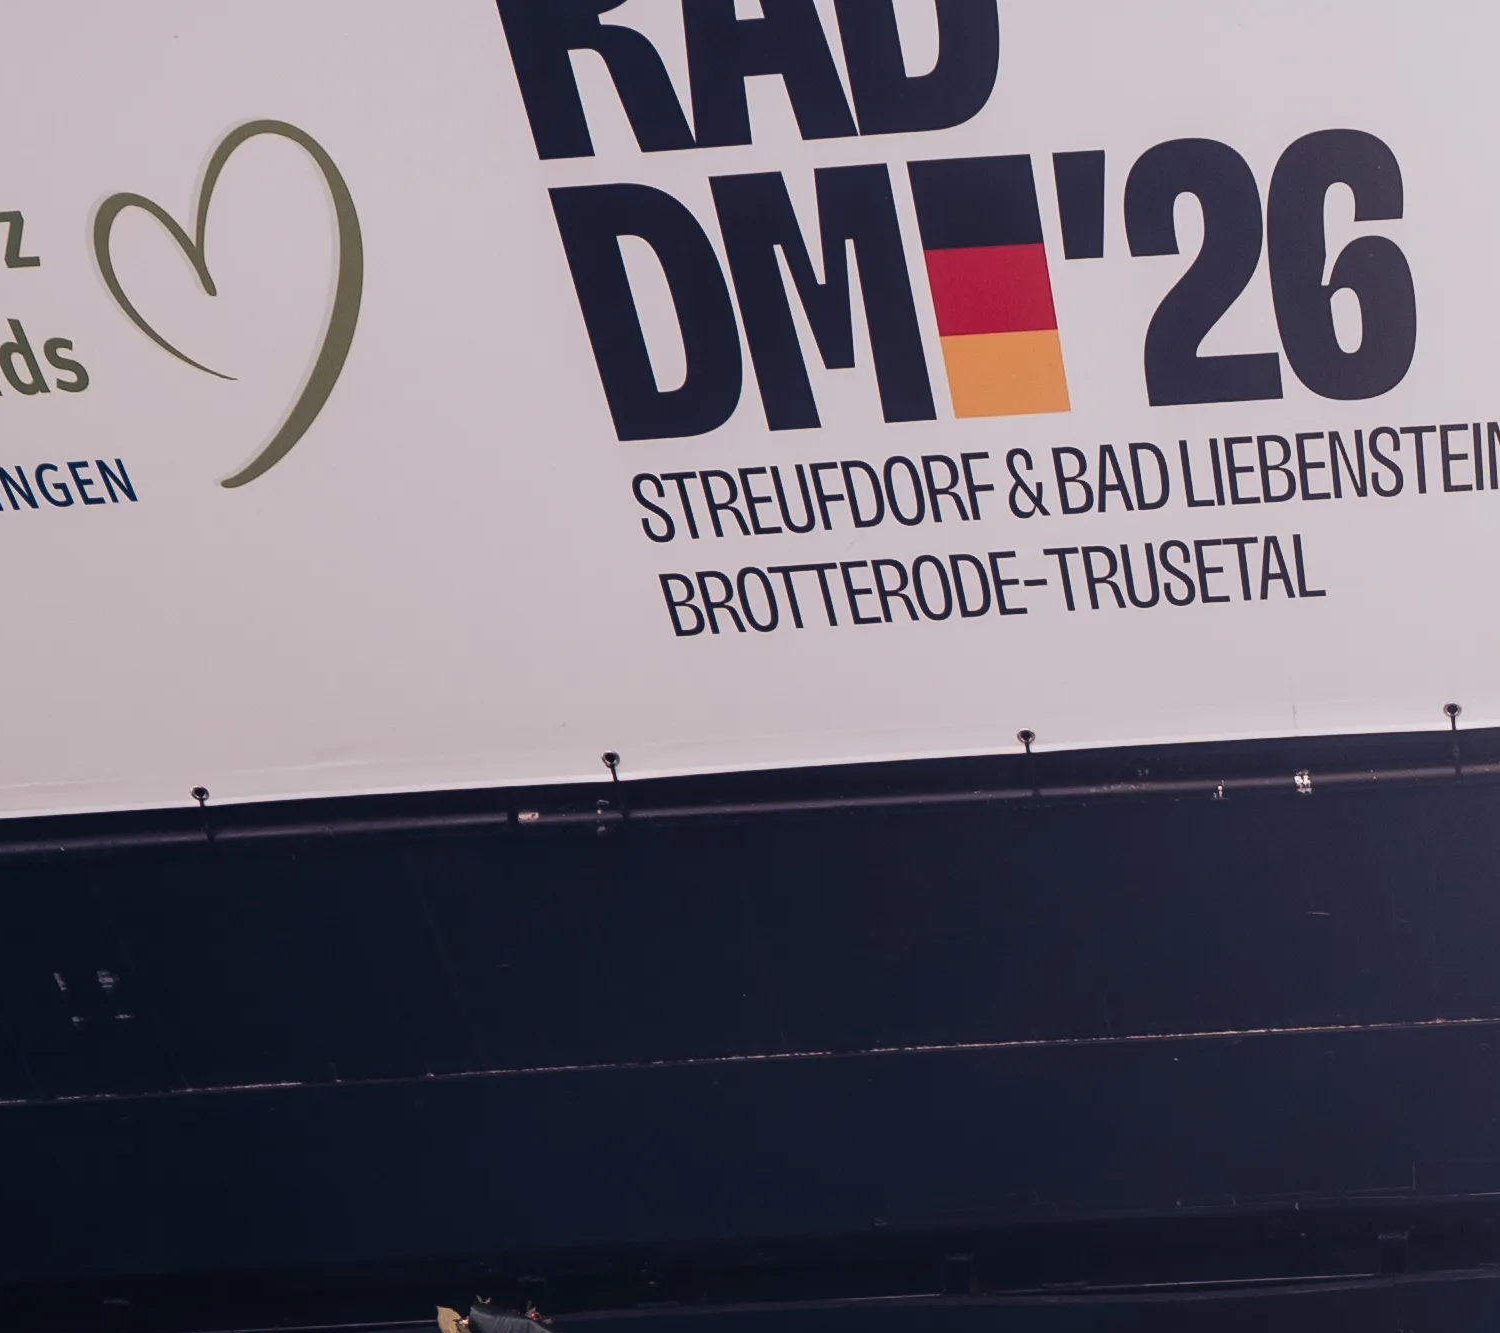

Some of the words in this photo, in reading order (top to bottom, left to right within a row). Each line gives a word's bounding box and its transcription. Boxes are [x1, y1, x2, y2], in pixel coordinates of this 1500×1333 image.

[498, 0, 999, 160] RAD
[547, 163, 937, 442] DM
[630, 451, 995, 543] STREUFDORF
[1007, 447, 1049, 519] &
[1051, 440, 1171, 515] BAD
[658, 534, 1326, 637] BROTTERODE-TRUSETAL
